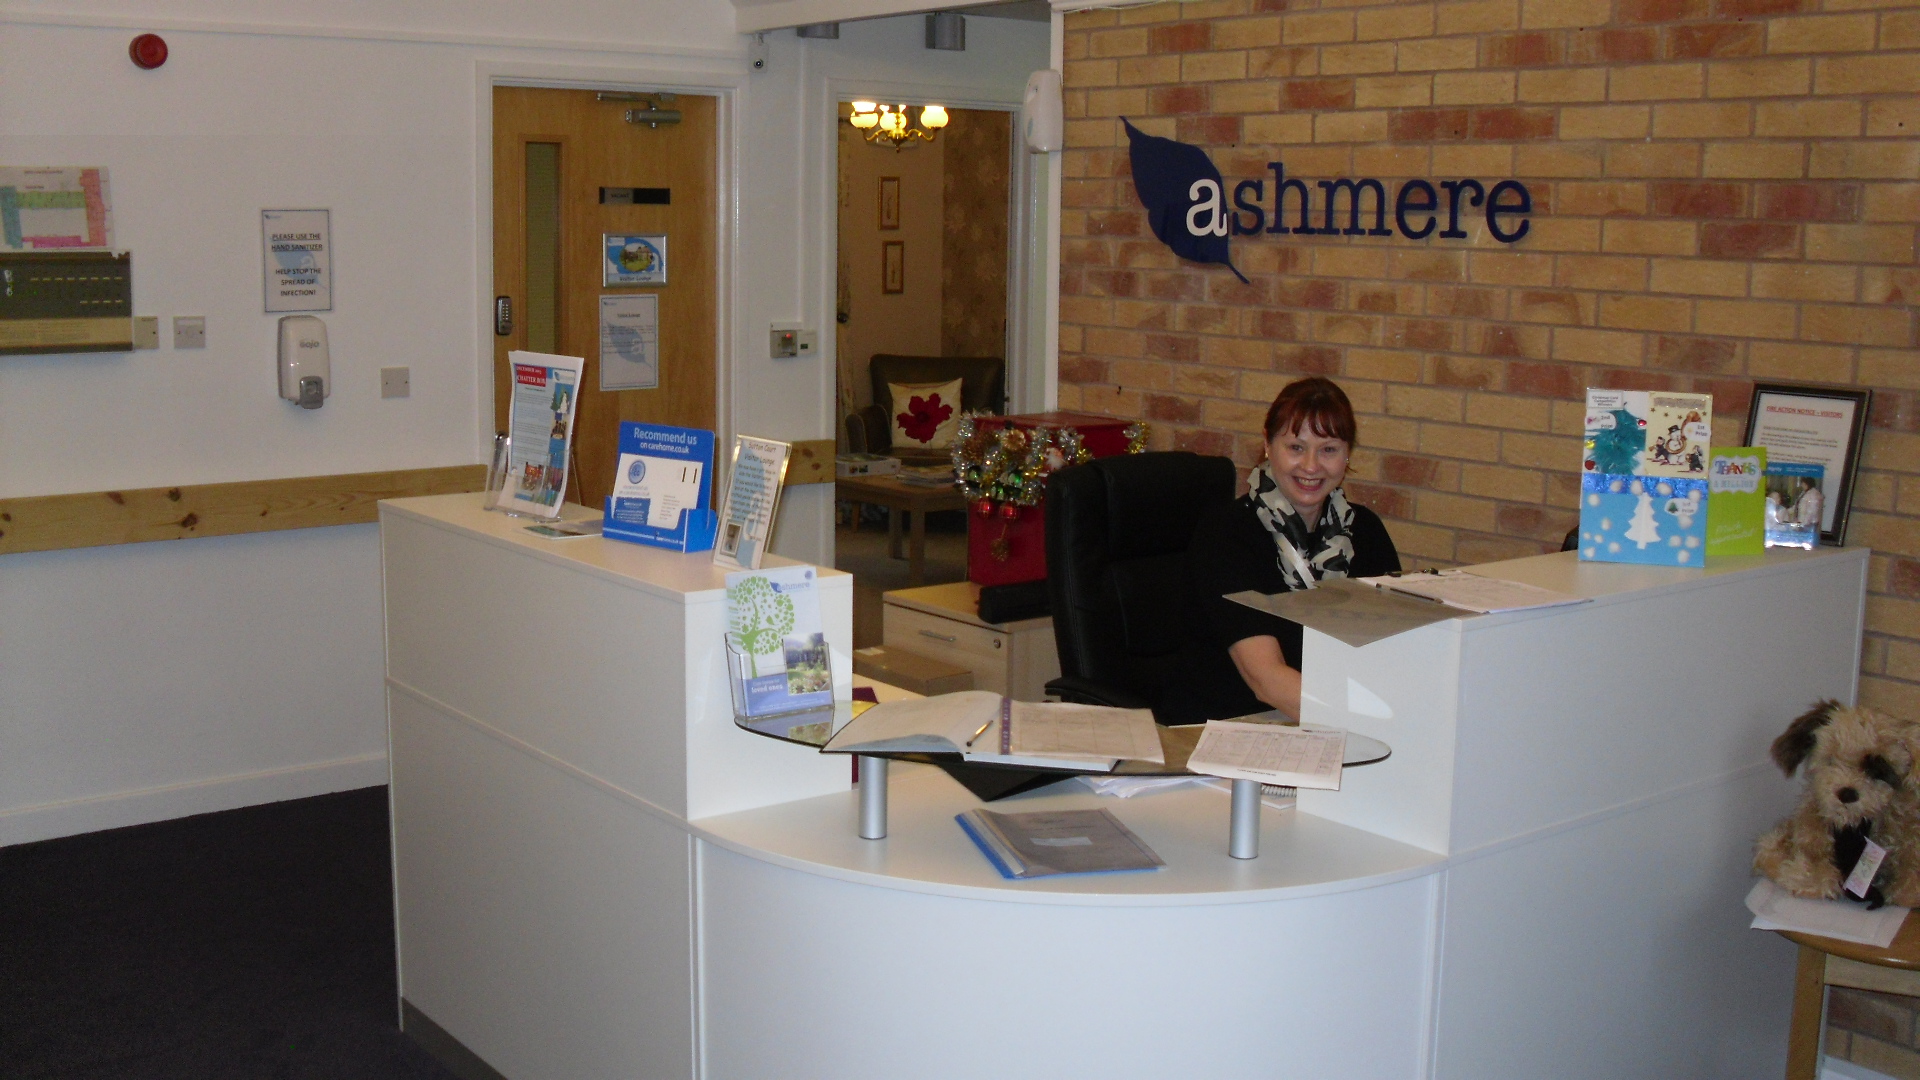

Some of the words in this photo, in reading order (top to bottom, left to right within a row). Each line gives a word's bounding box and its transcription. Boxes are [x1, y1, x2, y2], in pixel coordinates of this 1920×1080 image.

[1186, 162, 1531, 243] ashmere
[634, 427, 686, 443] Recommend
[687, 436, 697, 445] us
[777, 581, 810, 592] ashmere
